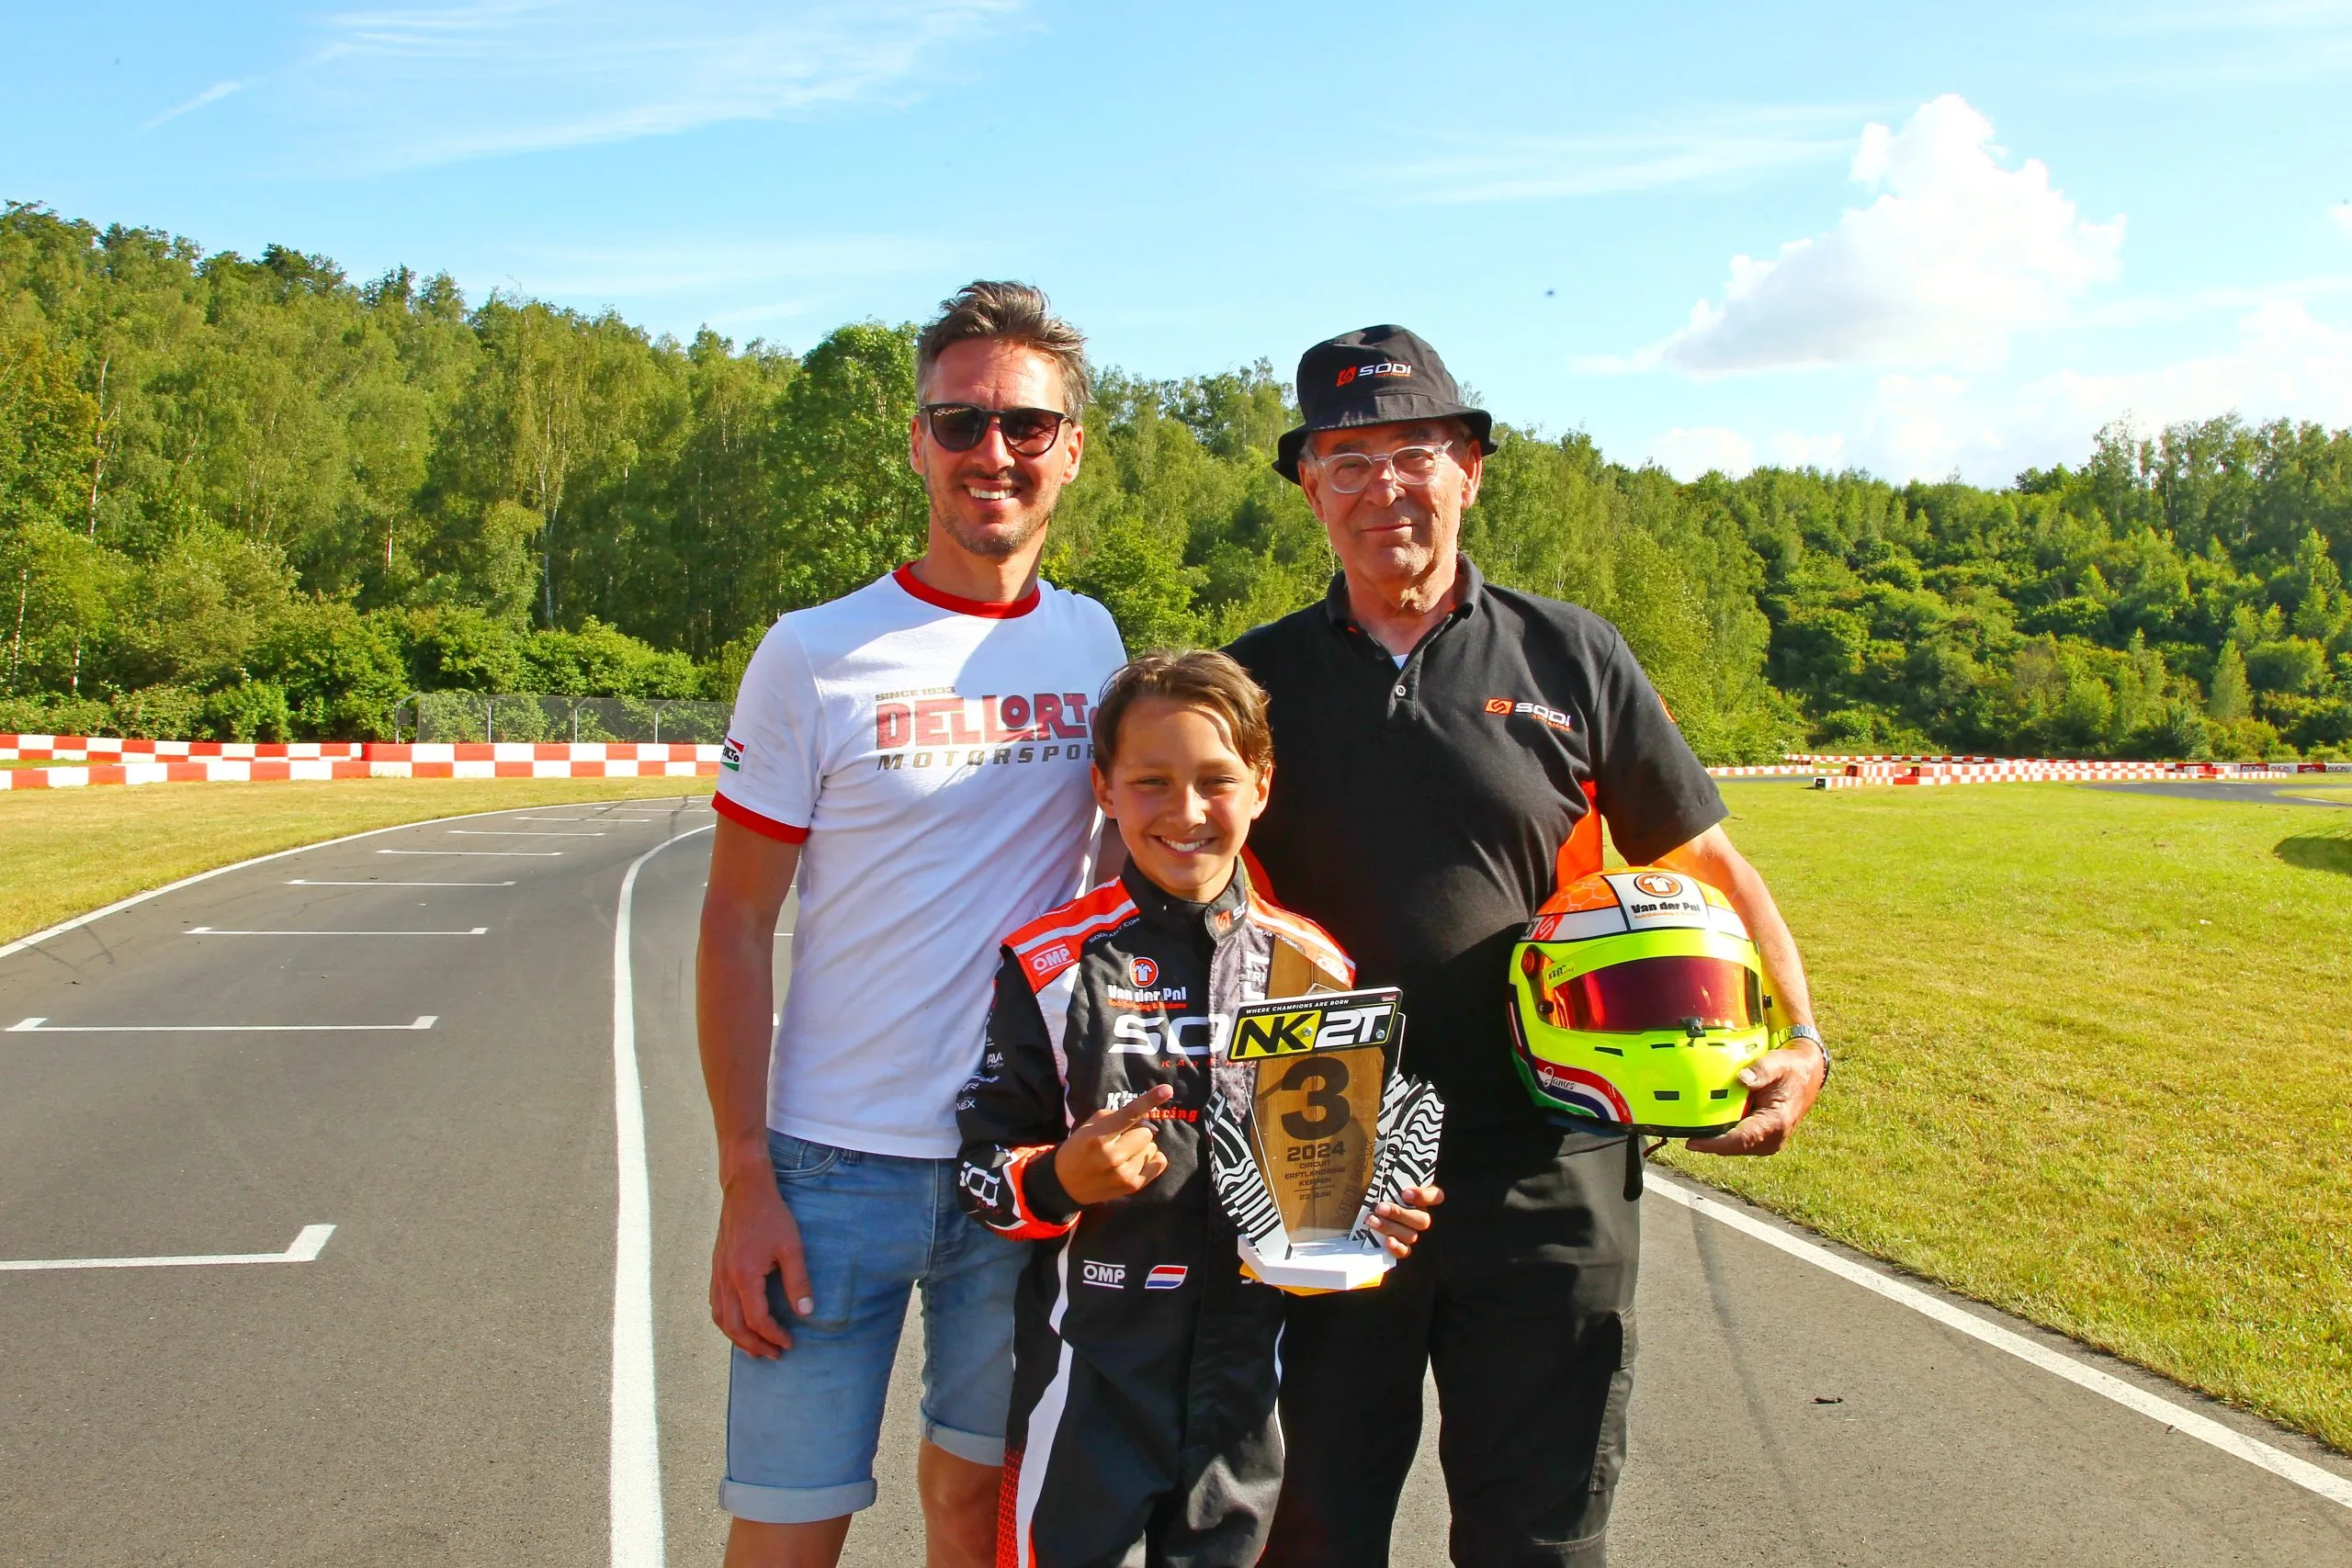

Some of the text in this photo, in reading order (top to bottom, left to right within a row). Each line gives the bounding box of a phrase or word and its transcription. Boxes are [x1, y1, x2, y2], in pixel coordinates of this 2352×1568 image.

[1359, 363, 1411, 377] SODI
[876, 686, 956, 701] SINCE 1933
[1515, 703, 1570, 727] SODI
[877, 744, 1095, 771] MOTORSPOR
[1631, 903, 1657, 913] Van
[1659, 901, 1679, 910] der
[1034, 948, 1069, 970] OMP
[1108, 985, 1133, 1000] Van
[1135, 989, 1160, 1002] der
[1272, 1003, 1313, 1011] CHAMPIONS
[1544, 1066, 1576, 1090] James
[1281, 1056, 1351, 1141] 3
[1148, 1107, 1198, 1122] acing
[1287, 1141, 1346, 1162] 2024
[1299, 1160, 1330, 1169] CIRCUIT
[1284, 1168, 1345, 1179] ERFTLANDRING
[1299, 1178, 1331, 1187] KERPEN
[1084, 1265, 1125, 1283] OMP
